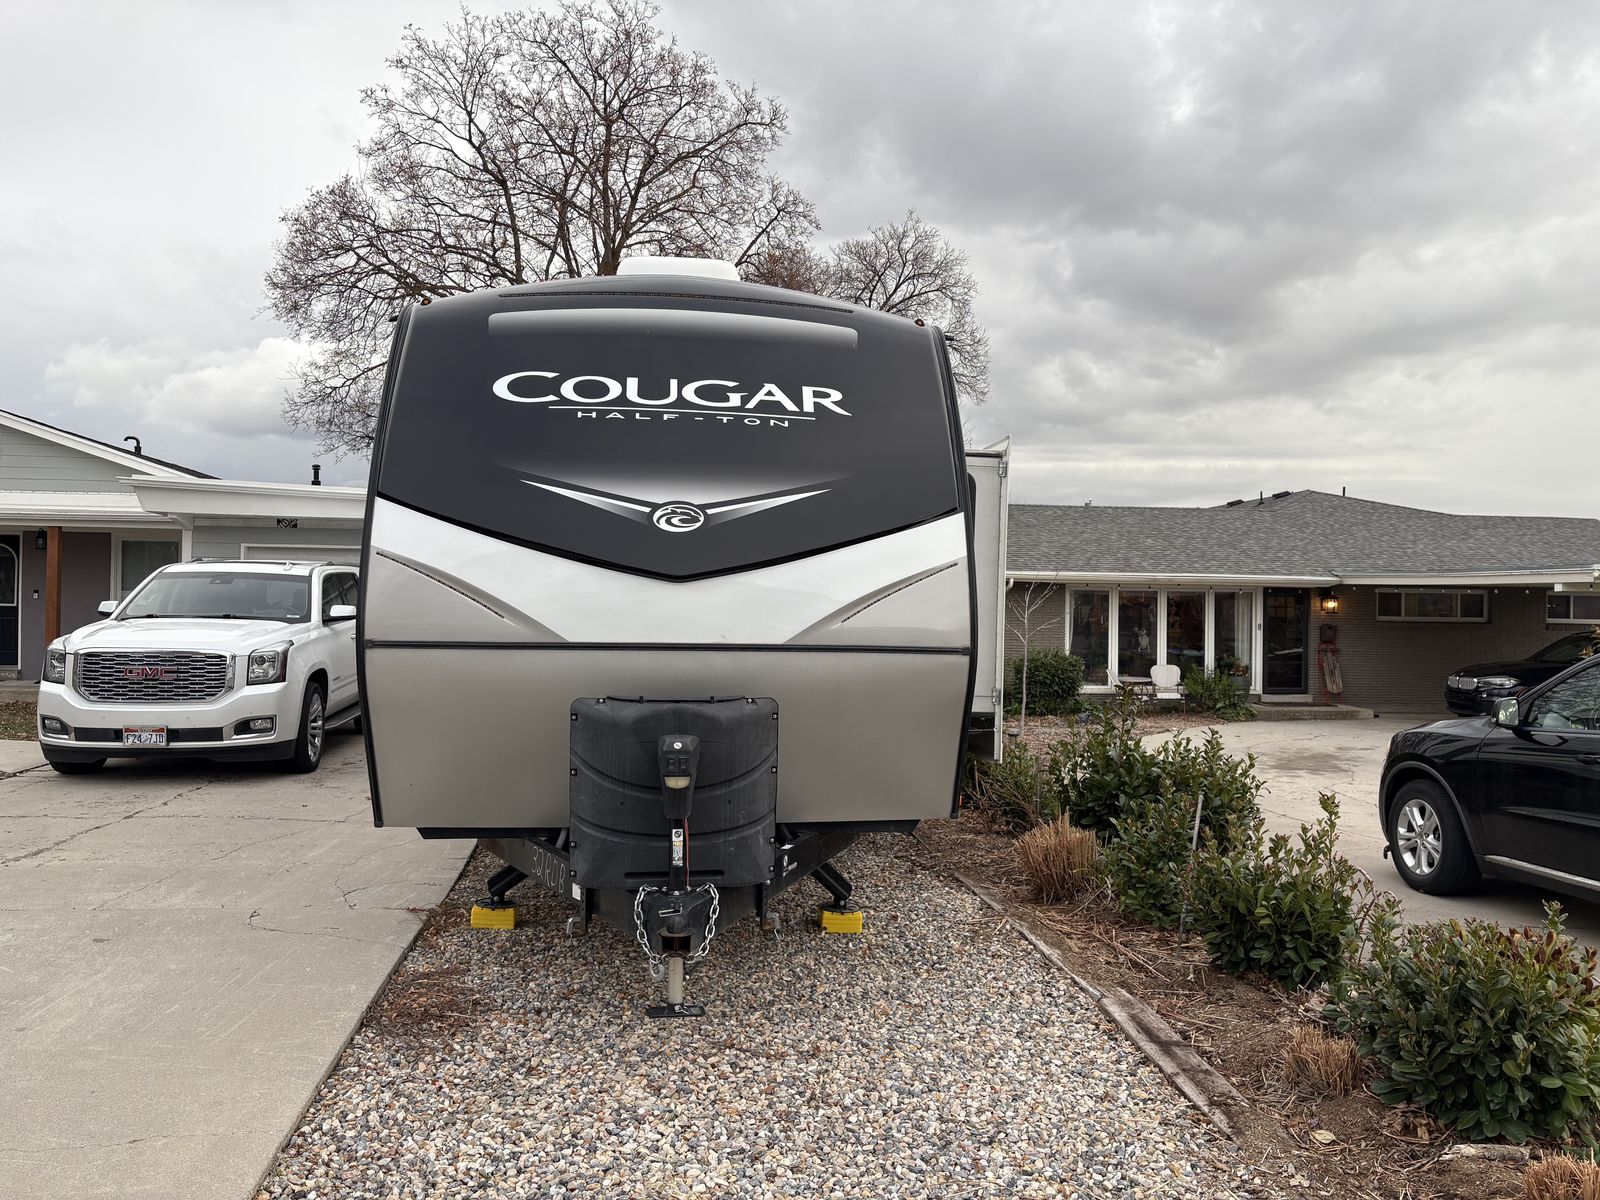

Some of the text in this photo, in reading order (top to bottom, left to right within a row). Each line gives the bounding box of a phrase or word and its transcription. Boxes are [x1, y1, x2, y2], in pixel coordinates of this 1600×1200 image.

[492, 370, 852, 417] COUGAR
[577, 411, 789, 428] HALF-TON
[124, 666, 177, 680] GMC
